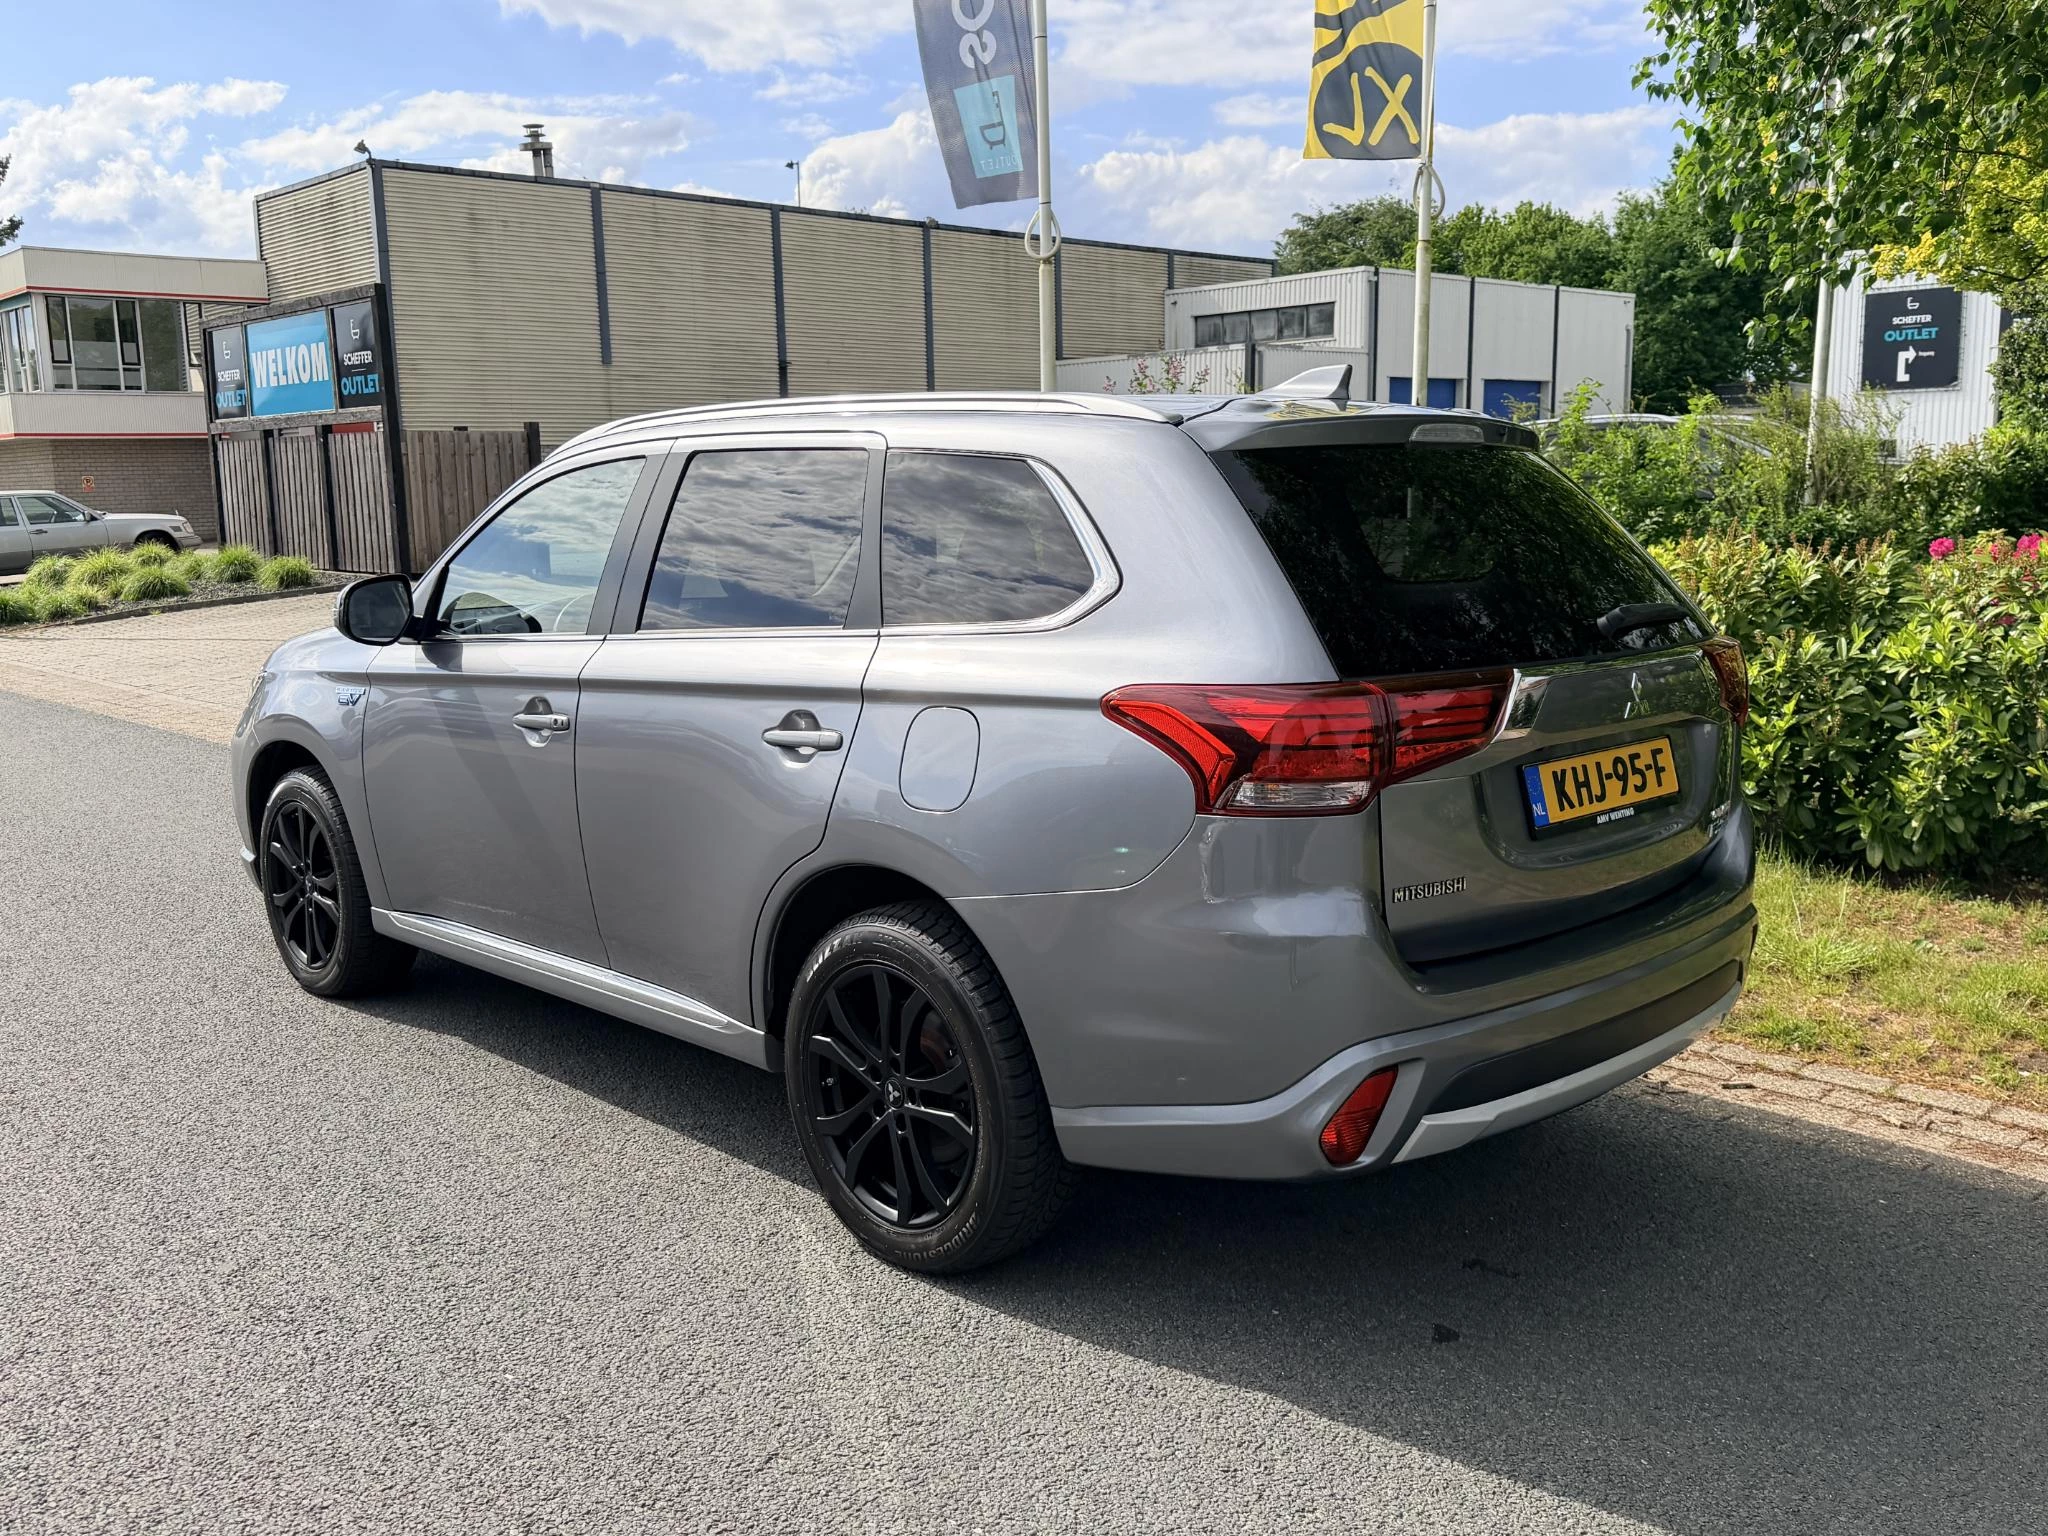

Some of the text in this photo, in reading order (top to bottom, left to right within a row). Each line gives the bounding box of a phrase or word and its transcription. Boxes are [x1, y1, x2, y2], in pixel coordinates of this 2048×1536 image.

[1892, 314, 1932, 325] SCHEFFER
[1884, 327, 1939, 342] OUTLET
[251, 341, 329, 389] WELKOM
[343, 350, 373, 366] SCHEFFER
[217, 369, 241, 382] SCHEFFER
[341, 373, 380, 396] OUTLET
[215, 388, 247, 409] OUTLET
[1551, 747, 1667, 812] KHJ-95-F
[1532, 802, 1546, 817] NL
[1392, 877, 1467, 903] MITSUBISHI
